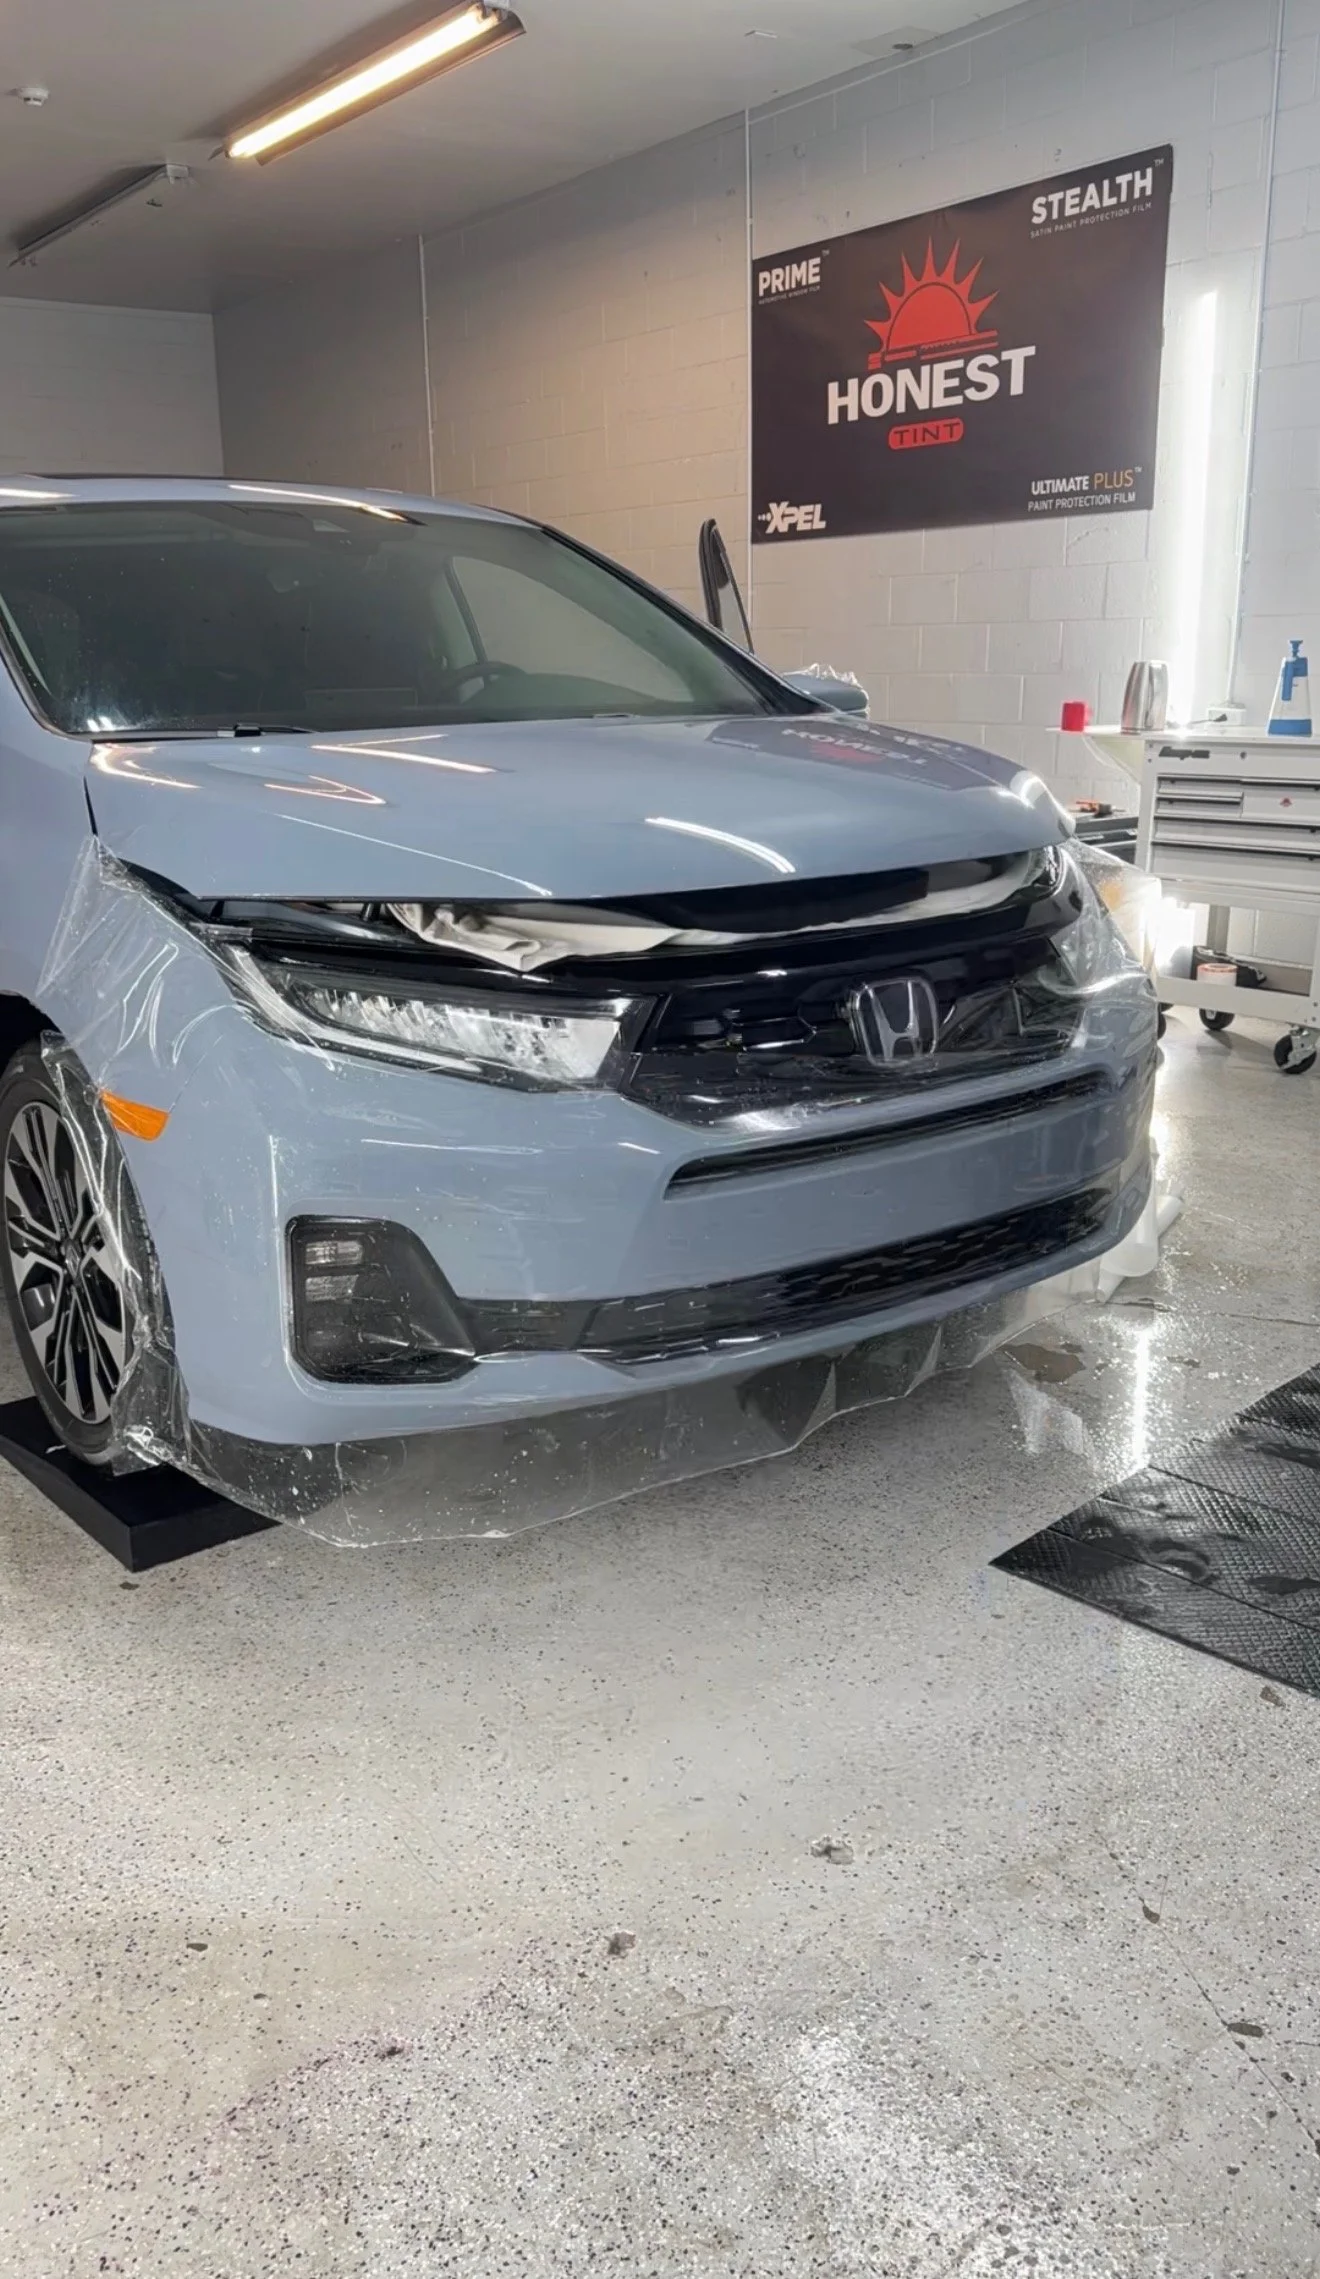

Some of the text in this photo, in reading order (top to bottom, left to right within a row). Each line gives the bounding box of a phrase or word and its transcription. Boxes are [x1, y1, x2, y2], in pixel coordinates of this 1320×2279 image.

[1030, 202, 1152, 239] SATIN PAINT PROTECTION FILM
[827, 345, 1036, 425] HONEST
[894, 421, 962, 446] TINT
[1030, 475, 1090, 496] ULTIMATE
[1027, 491, 1136, 512] PAINT PROTECTION FILM
[764, 500, 827, 534] XPEL
